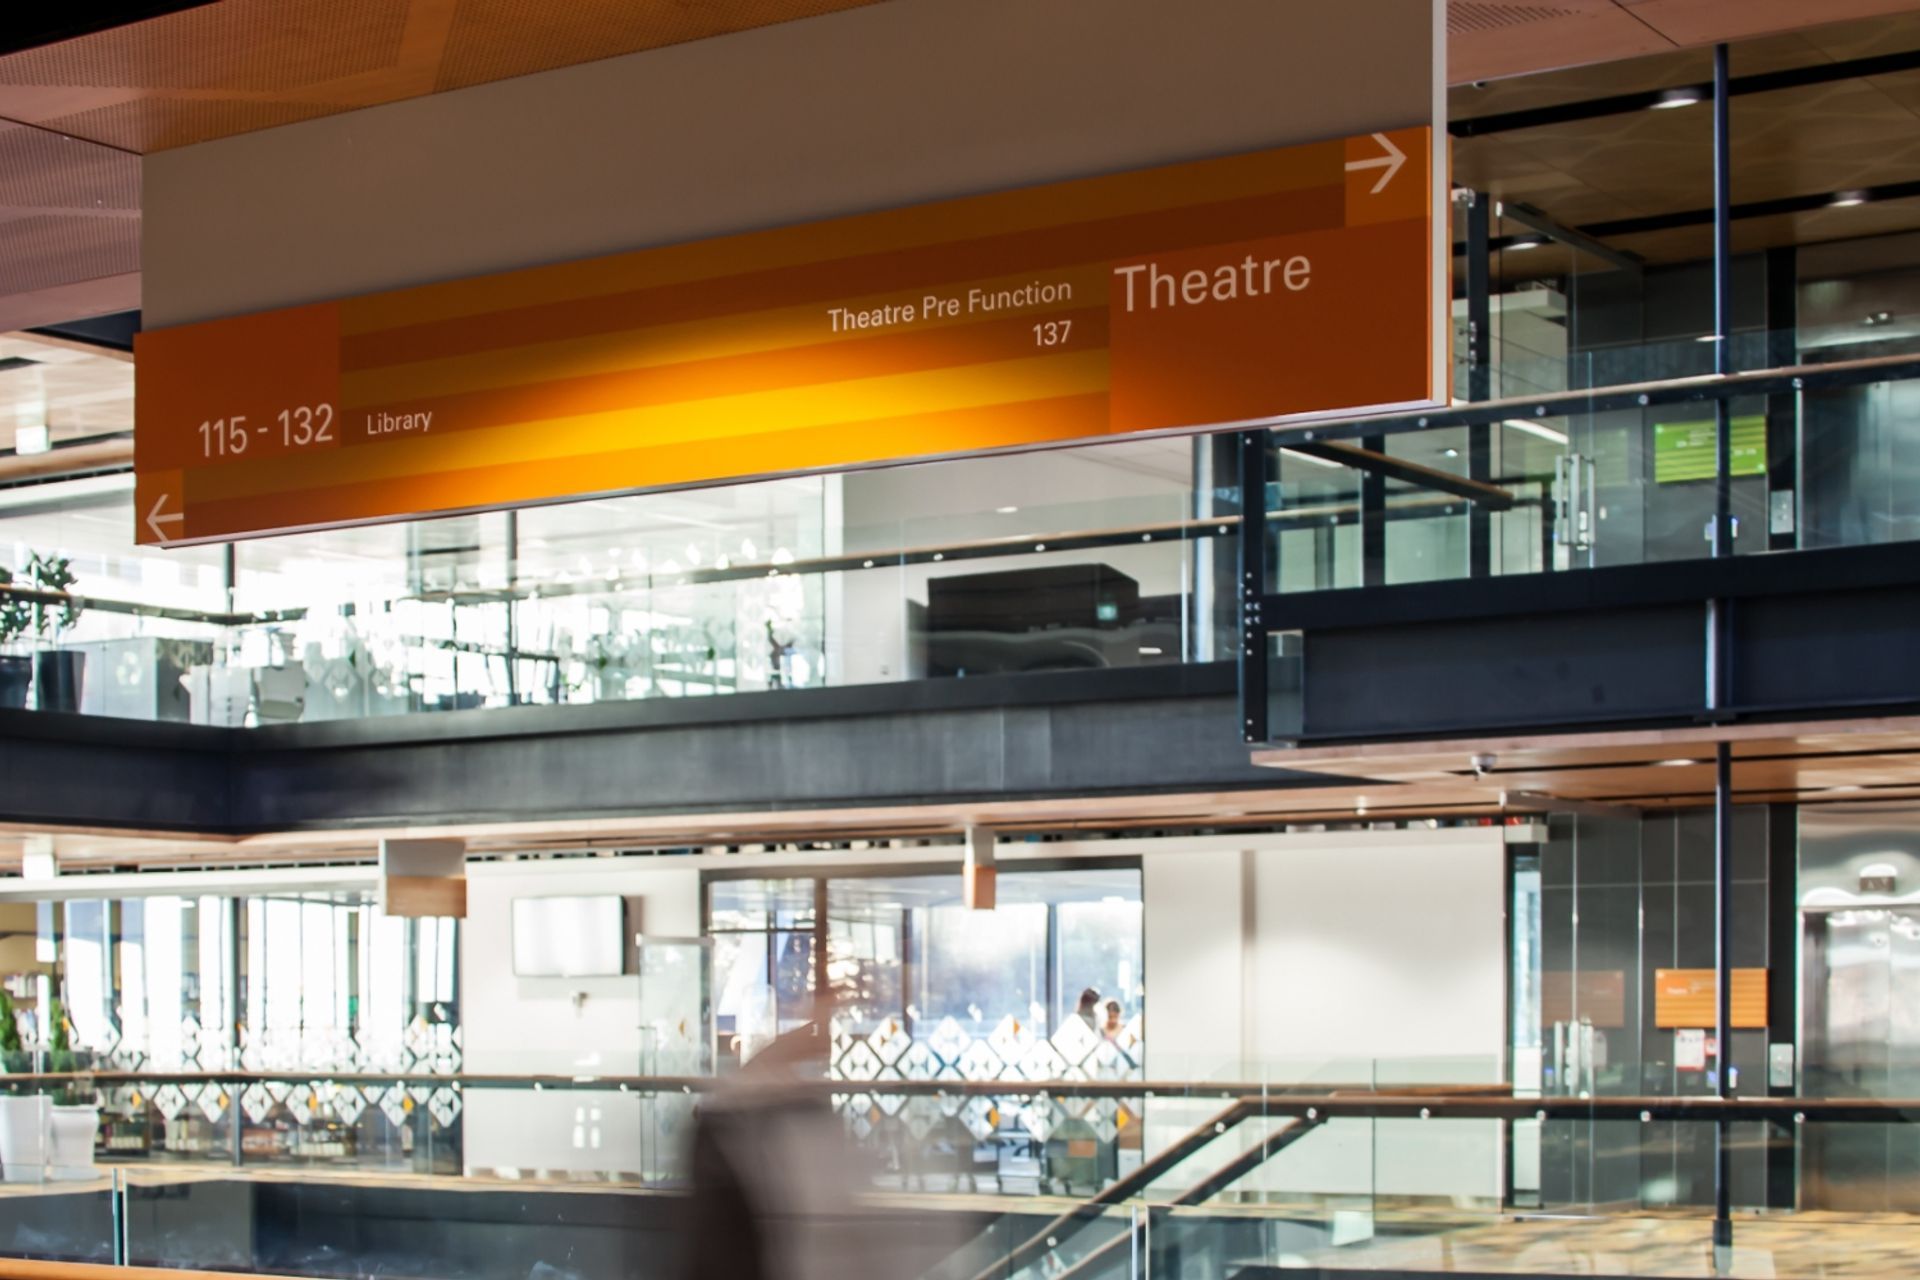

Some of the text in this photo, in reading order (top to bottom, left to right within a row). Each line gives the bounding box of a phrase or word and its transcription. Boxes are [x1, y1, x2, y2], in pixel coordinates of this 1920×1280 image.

[827, 281, 1072, 332] Theatre Pre Function
[1113, 254, 1312, 313] Theatre
[1033, 320, 1072, 346] 137
[199, 403, 334, 457] 115 - 132
[366, 411, 433, 435] Library
